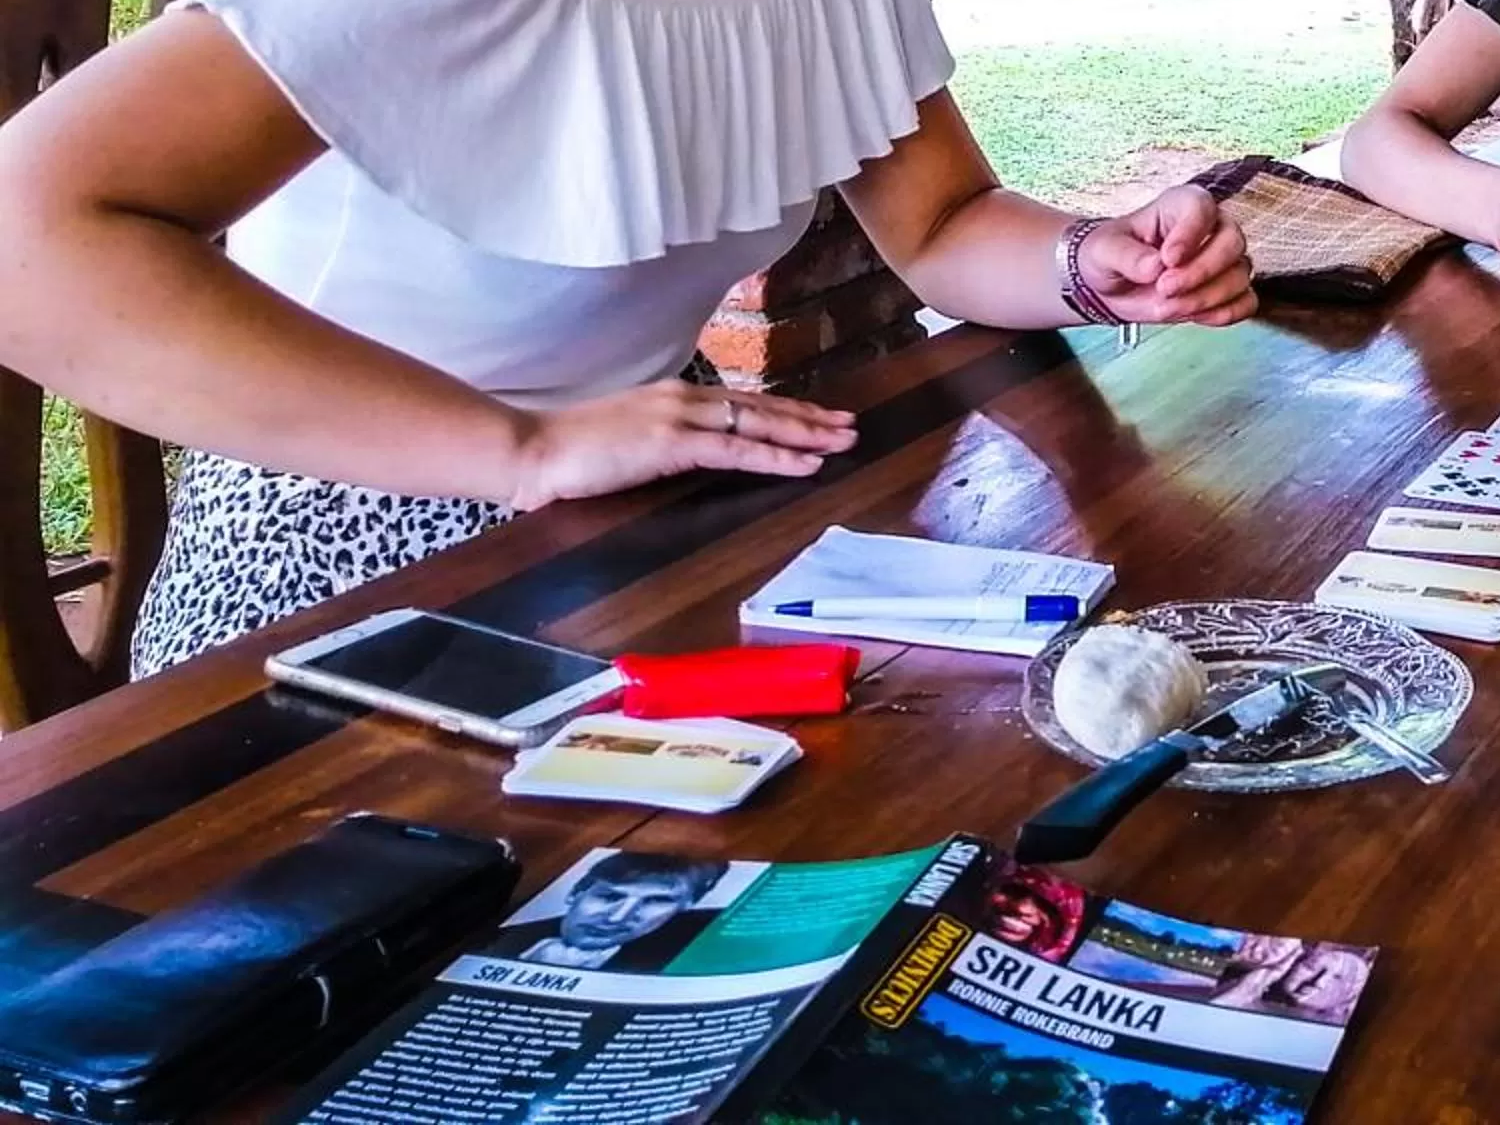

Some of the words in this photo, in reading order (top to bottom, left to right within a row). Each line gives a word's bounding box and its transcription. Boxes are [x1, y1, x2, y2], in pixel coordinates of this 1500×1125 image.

[940, 840, 981, 866] SRI
[903, 862, 962, 908] LANKA
[473, 964, 515, 983] SRI
[510, 970, 582, 992] LANKA
[870, 919, 963, 1021] DOMINICUS
[967, 944, 1035, 991] SRI
[1037, 974, 1166, 1033] LANKA
[947, 978, 1012, 1017] RONNIE
[1011, 1006, 1116, 1050] ROKEBRAND
